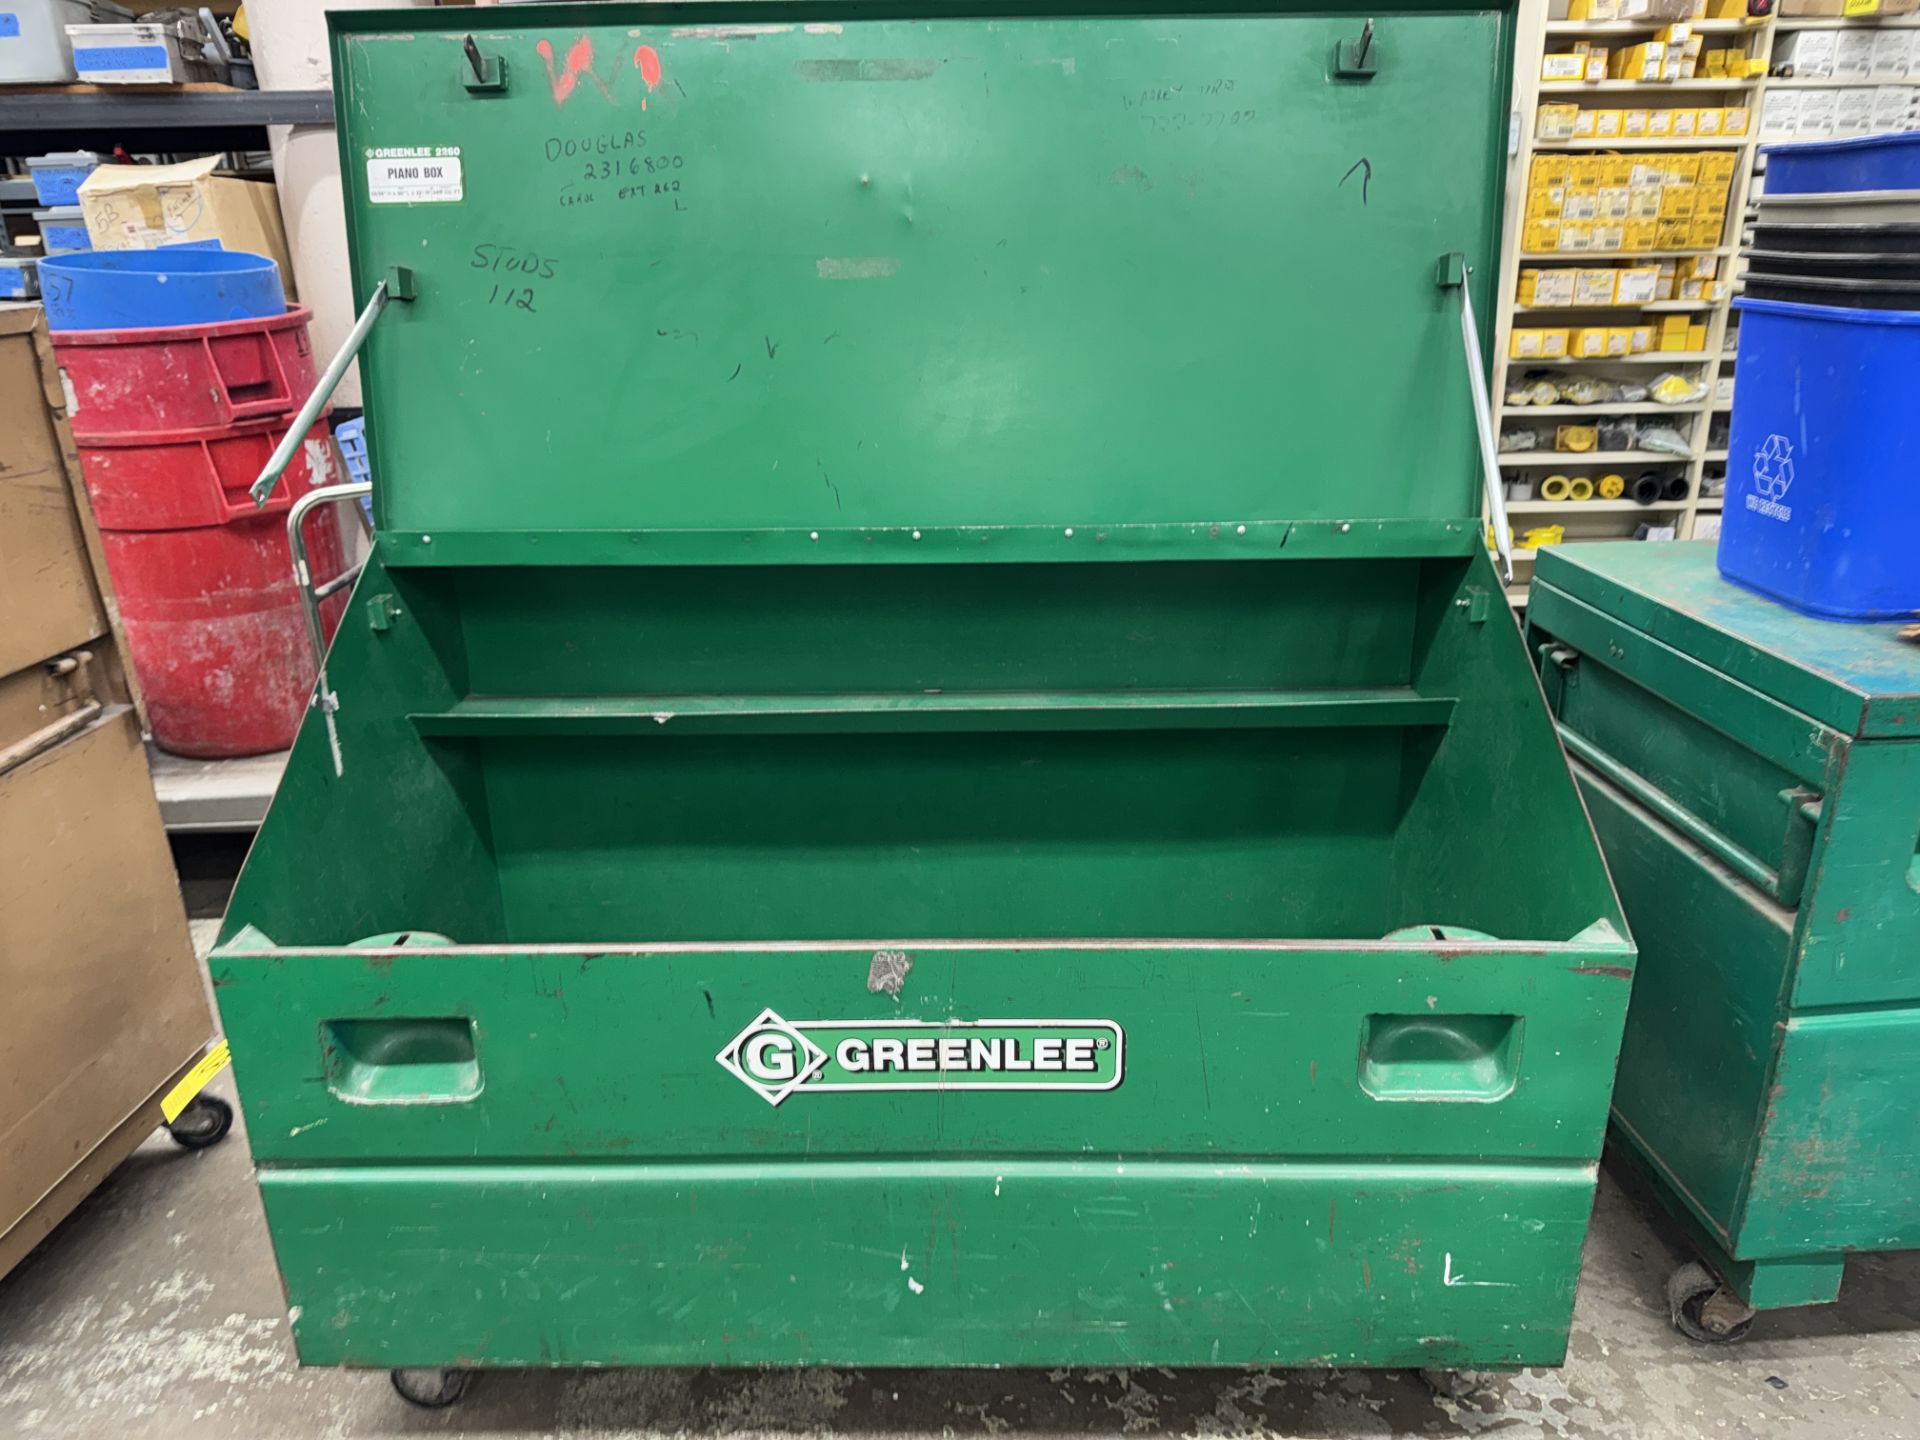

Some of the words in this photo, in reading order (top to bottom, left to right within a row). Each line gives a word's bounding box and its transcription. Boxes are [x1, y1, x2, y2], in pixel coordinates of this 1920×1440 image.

[375, 147, 432, 158] GREENLEE
[545, 130, 647, 162] DOUGLAS
[387, 167, 419, 179] PIANO
[423, 166, 444, 179] BOX
[584, 155, 684, 180] 2316800
[471, 243, 559, 279] STUDS
[488, 283, 537, 313] 112
[745, 1034, 798, 1081] G
[835, 1036, 1099, 1073] GREENLEE
